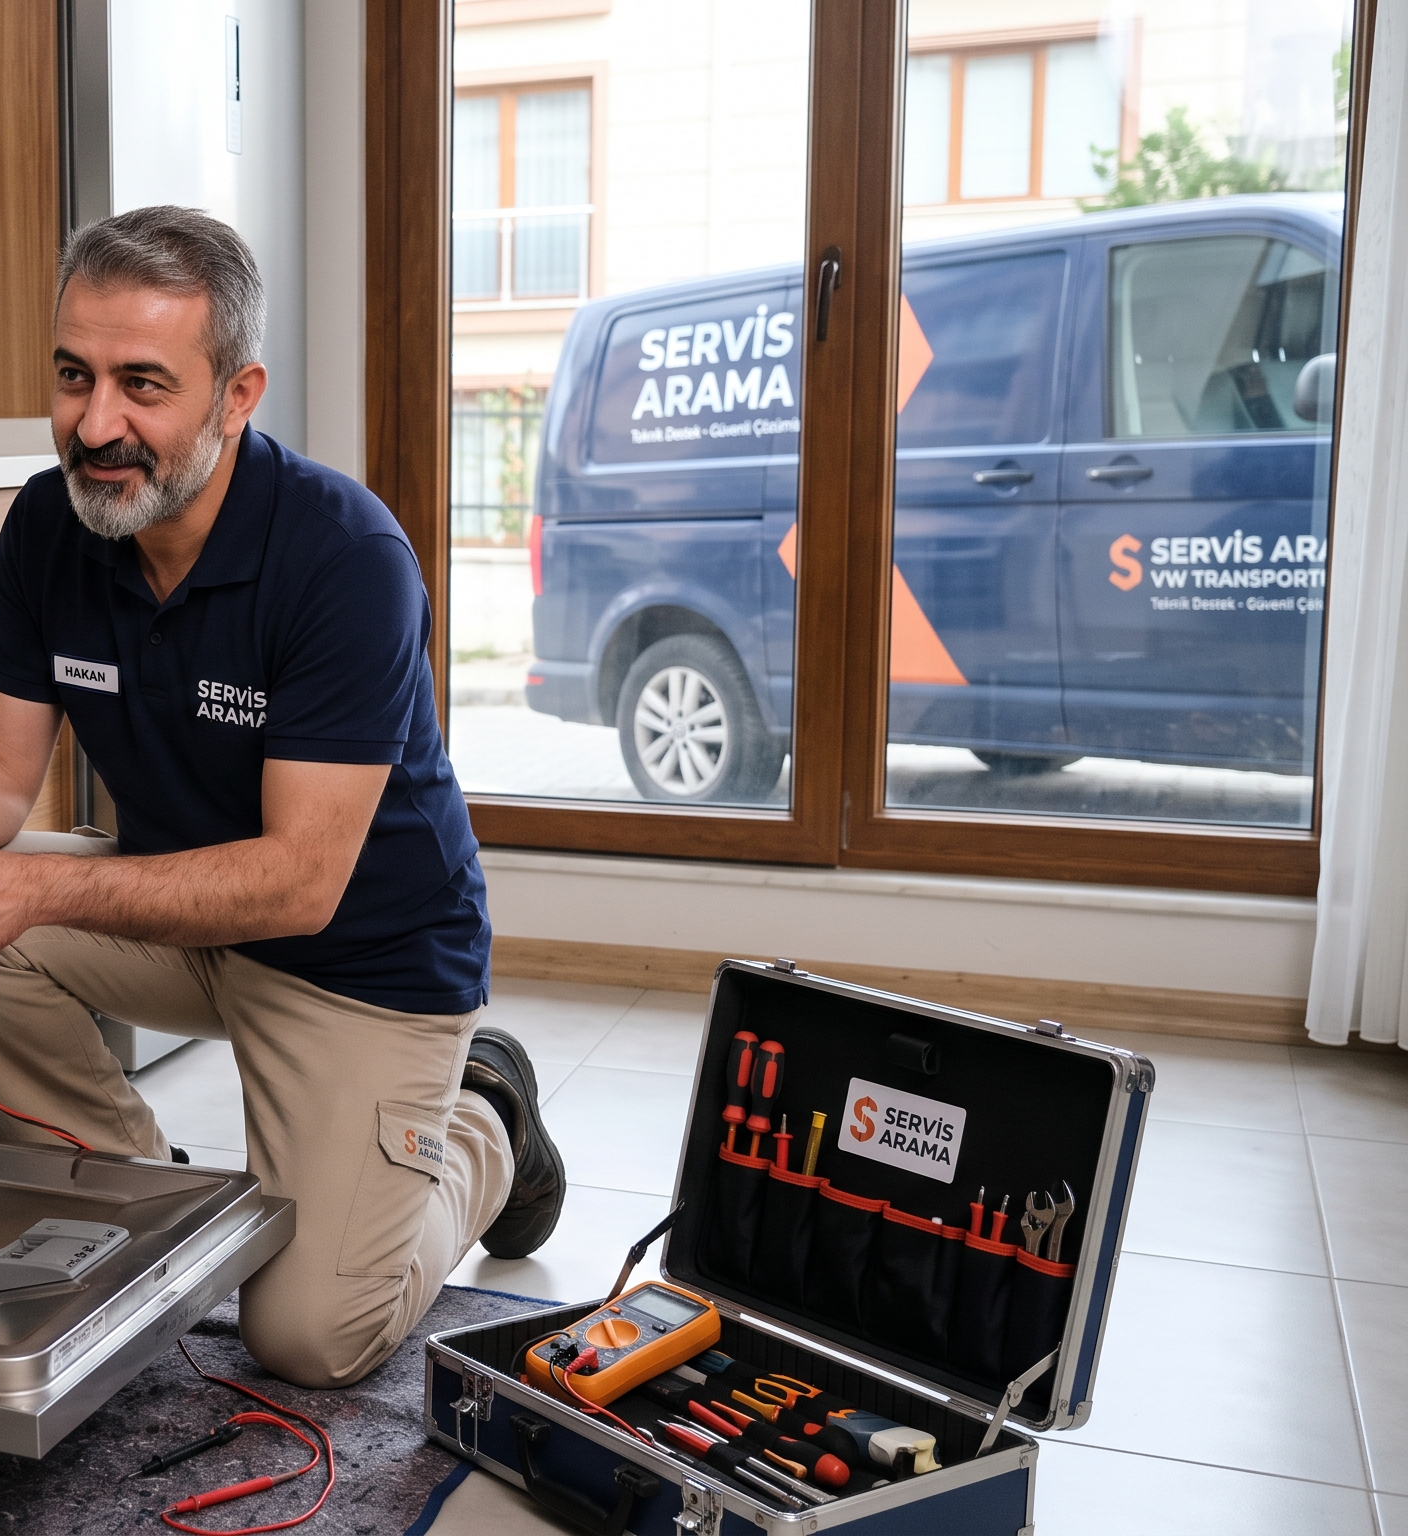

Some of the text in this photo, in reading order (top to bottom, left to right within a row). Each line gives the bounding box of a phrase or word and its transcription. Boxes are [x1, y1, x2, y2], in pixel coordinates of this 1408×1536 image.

[638, 303, 795, 371] SERVİS
[631, 363, 795, 420] ARAMA
[1150, 529, 1263, 565] SERVİS
[1150, 569, 1188, 588] VW
[64, 665, 106, 683] HAKAN
[197, 679, 267, 708] SERVİS
[196, 701, 267, 728] ARAMA
[883, 1107, 954, 1142] SERVİS
[878, 1129, 951, 1165] ARAMA
